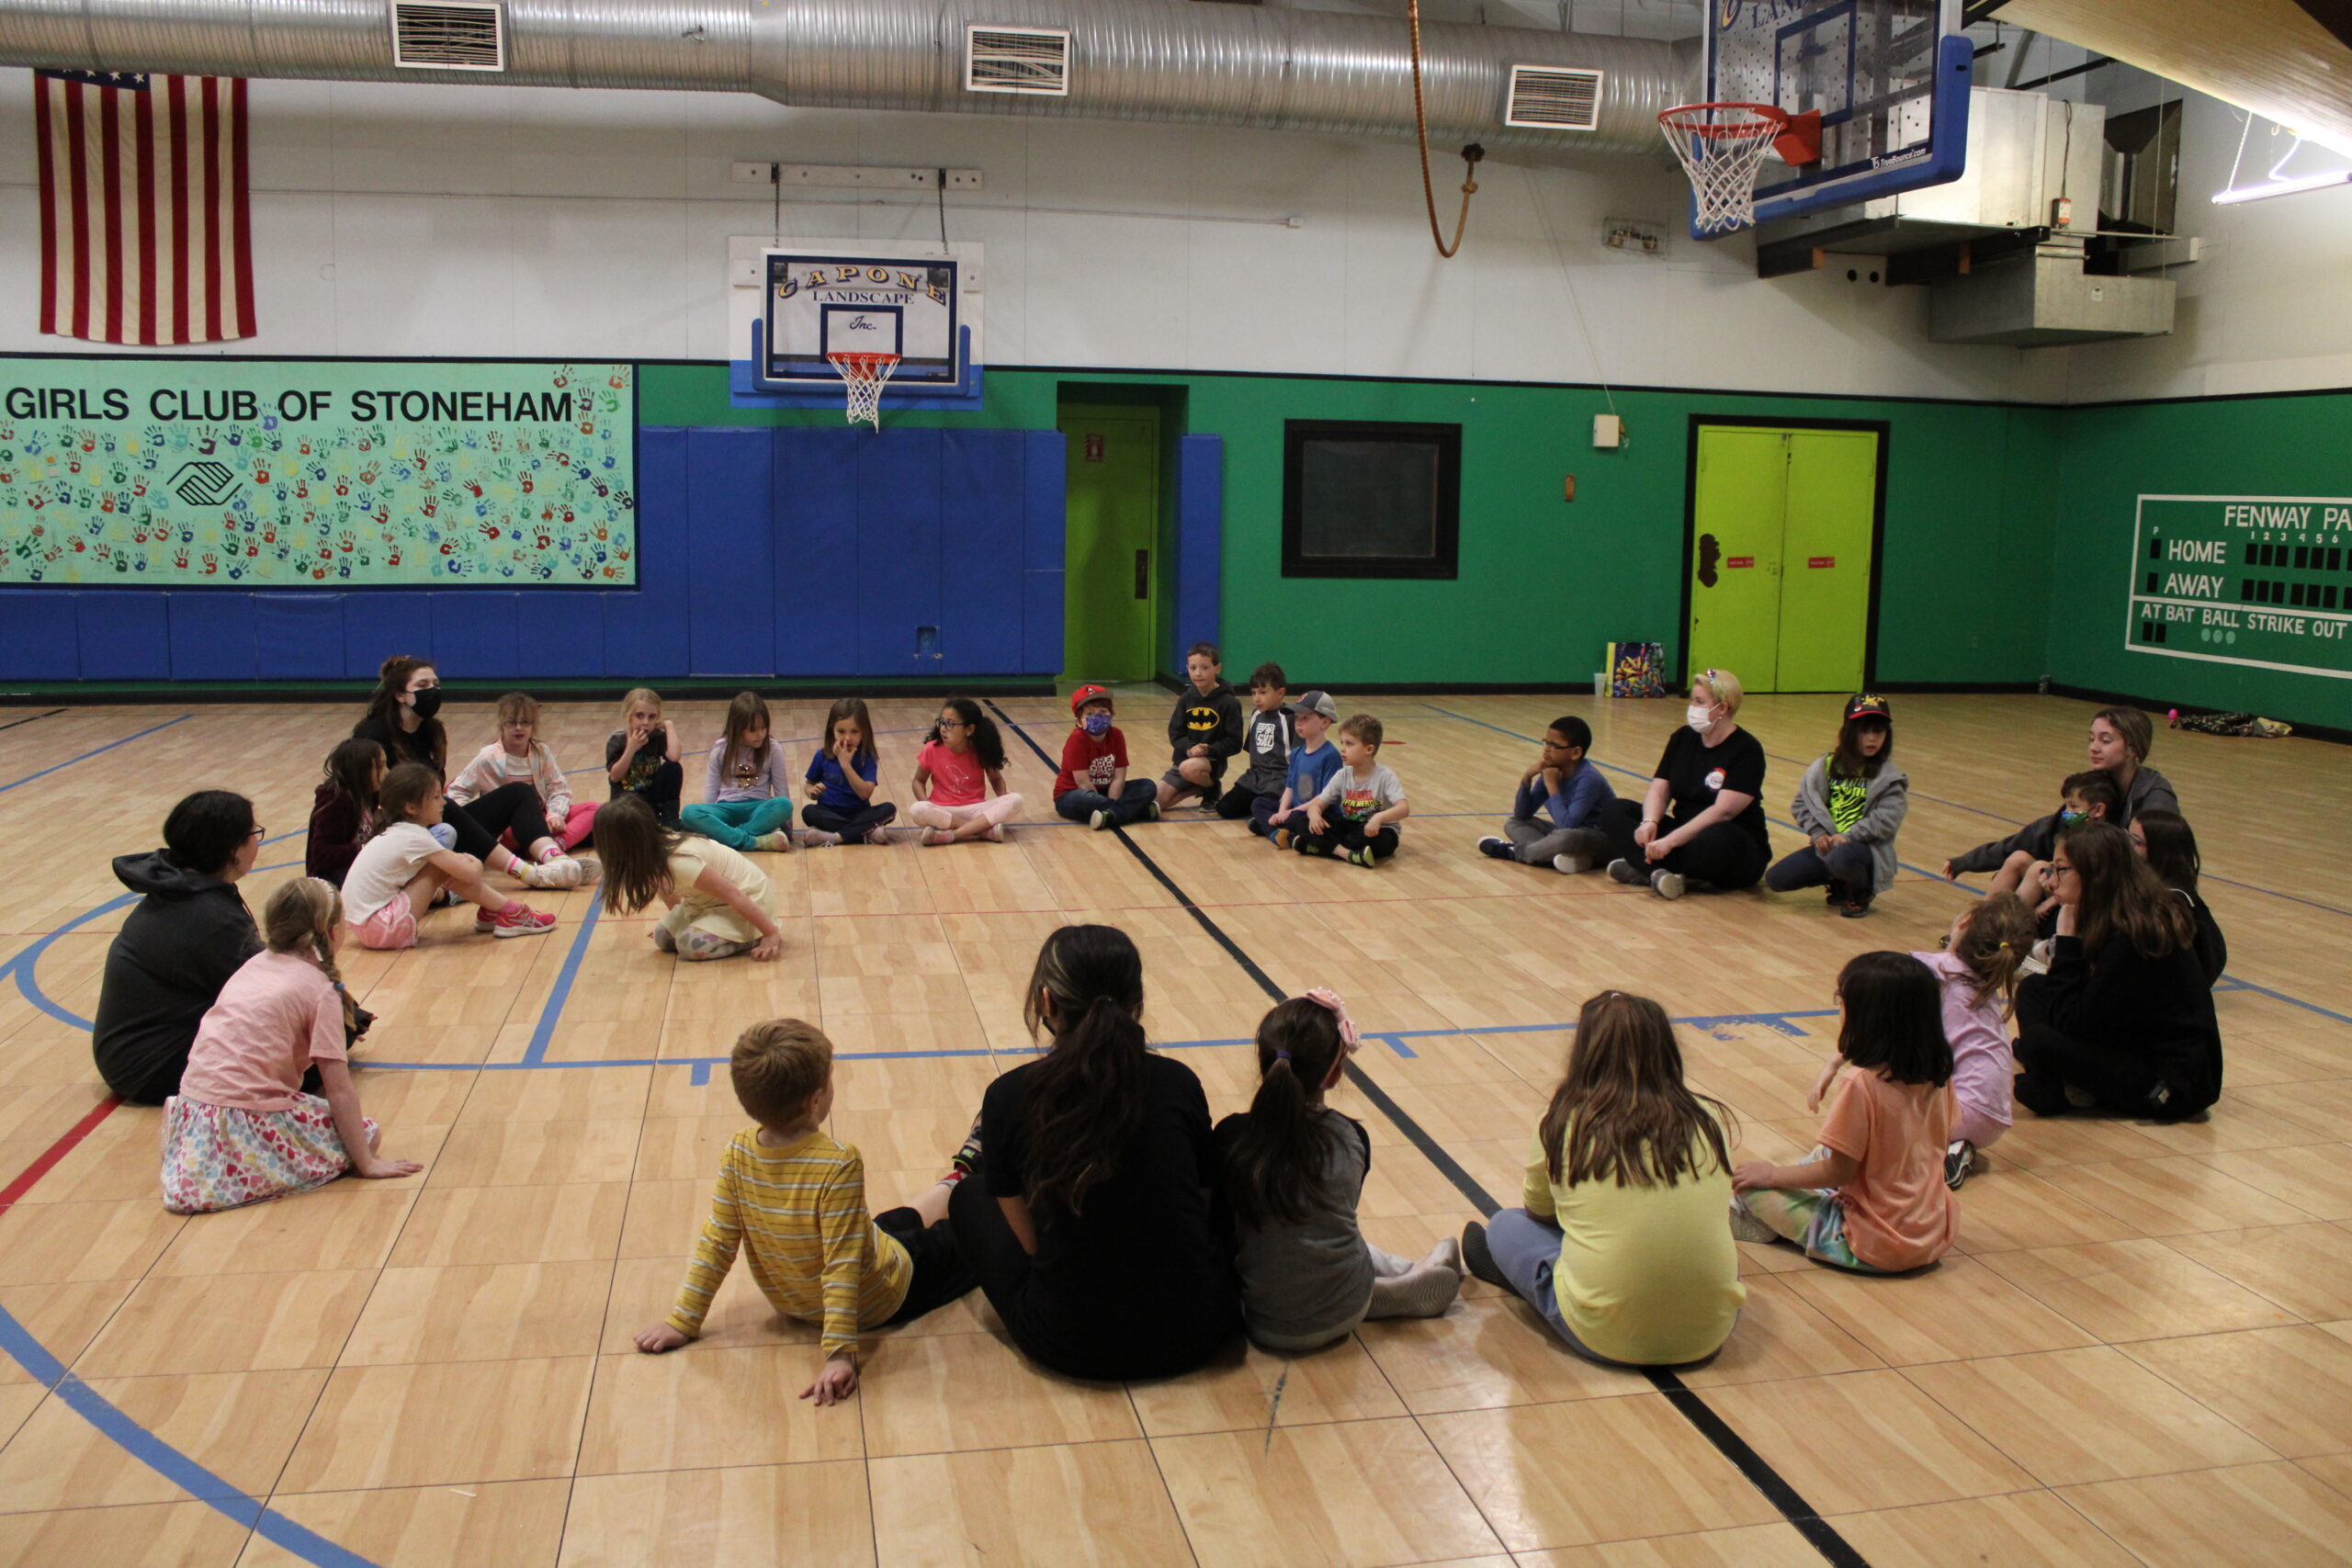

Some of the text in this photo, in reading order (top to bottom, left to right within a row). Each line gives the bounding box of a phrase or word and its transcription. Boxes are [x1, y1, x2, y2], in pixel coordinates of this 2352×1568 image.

[778, 266, 946, 307] CAPONE
[813, 290, 914, 304] LANDSCAPE
[850, 316, 876, 331] Inc.
[6, 387, 572, 422] GIRLS CLUB OF STONEHAM
[2224, 505, 2312, 529] FENWAY
[2250, 531, 2339, 544] 1 2 3 4 5 6
[2168, 538, 2227, 564] HOME
[2164, 572, 2224, 598] AWAY
[2142, 603, 2347, 639] AT BAT BALL STRIKE OUT
